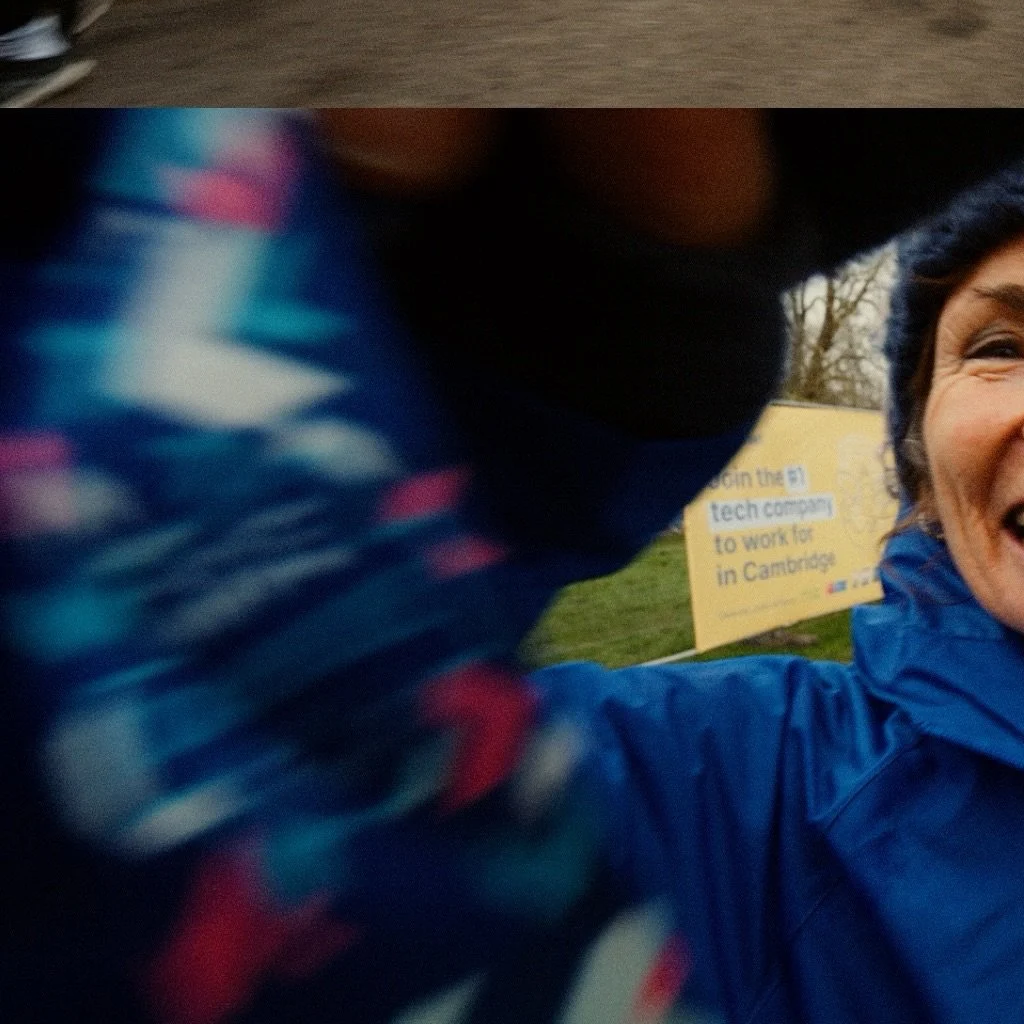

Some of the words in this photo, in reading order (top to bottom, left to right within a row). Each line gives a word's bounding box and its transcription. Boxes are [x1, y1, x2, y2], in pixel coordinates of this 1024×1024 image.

[757, 466, 785, 488] the
[710, 500, 760, 523] tech
[763, 497, 833, 522] company
[714, 535, 737, 556] to
[741, 529, 788, 552] work
[792, 526, 813, 545] for
[716, 564, 738, 587] in
[743, 552, 836, 581] Cambridge
